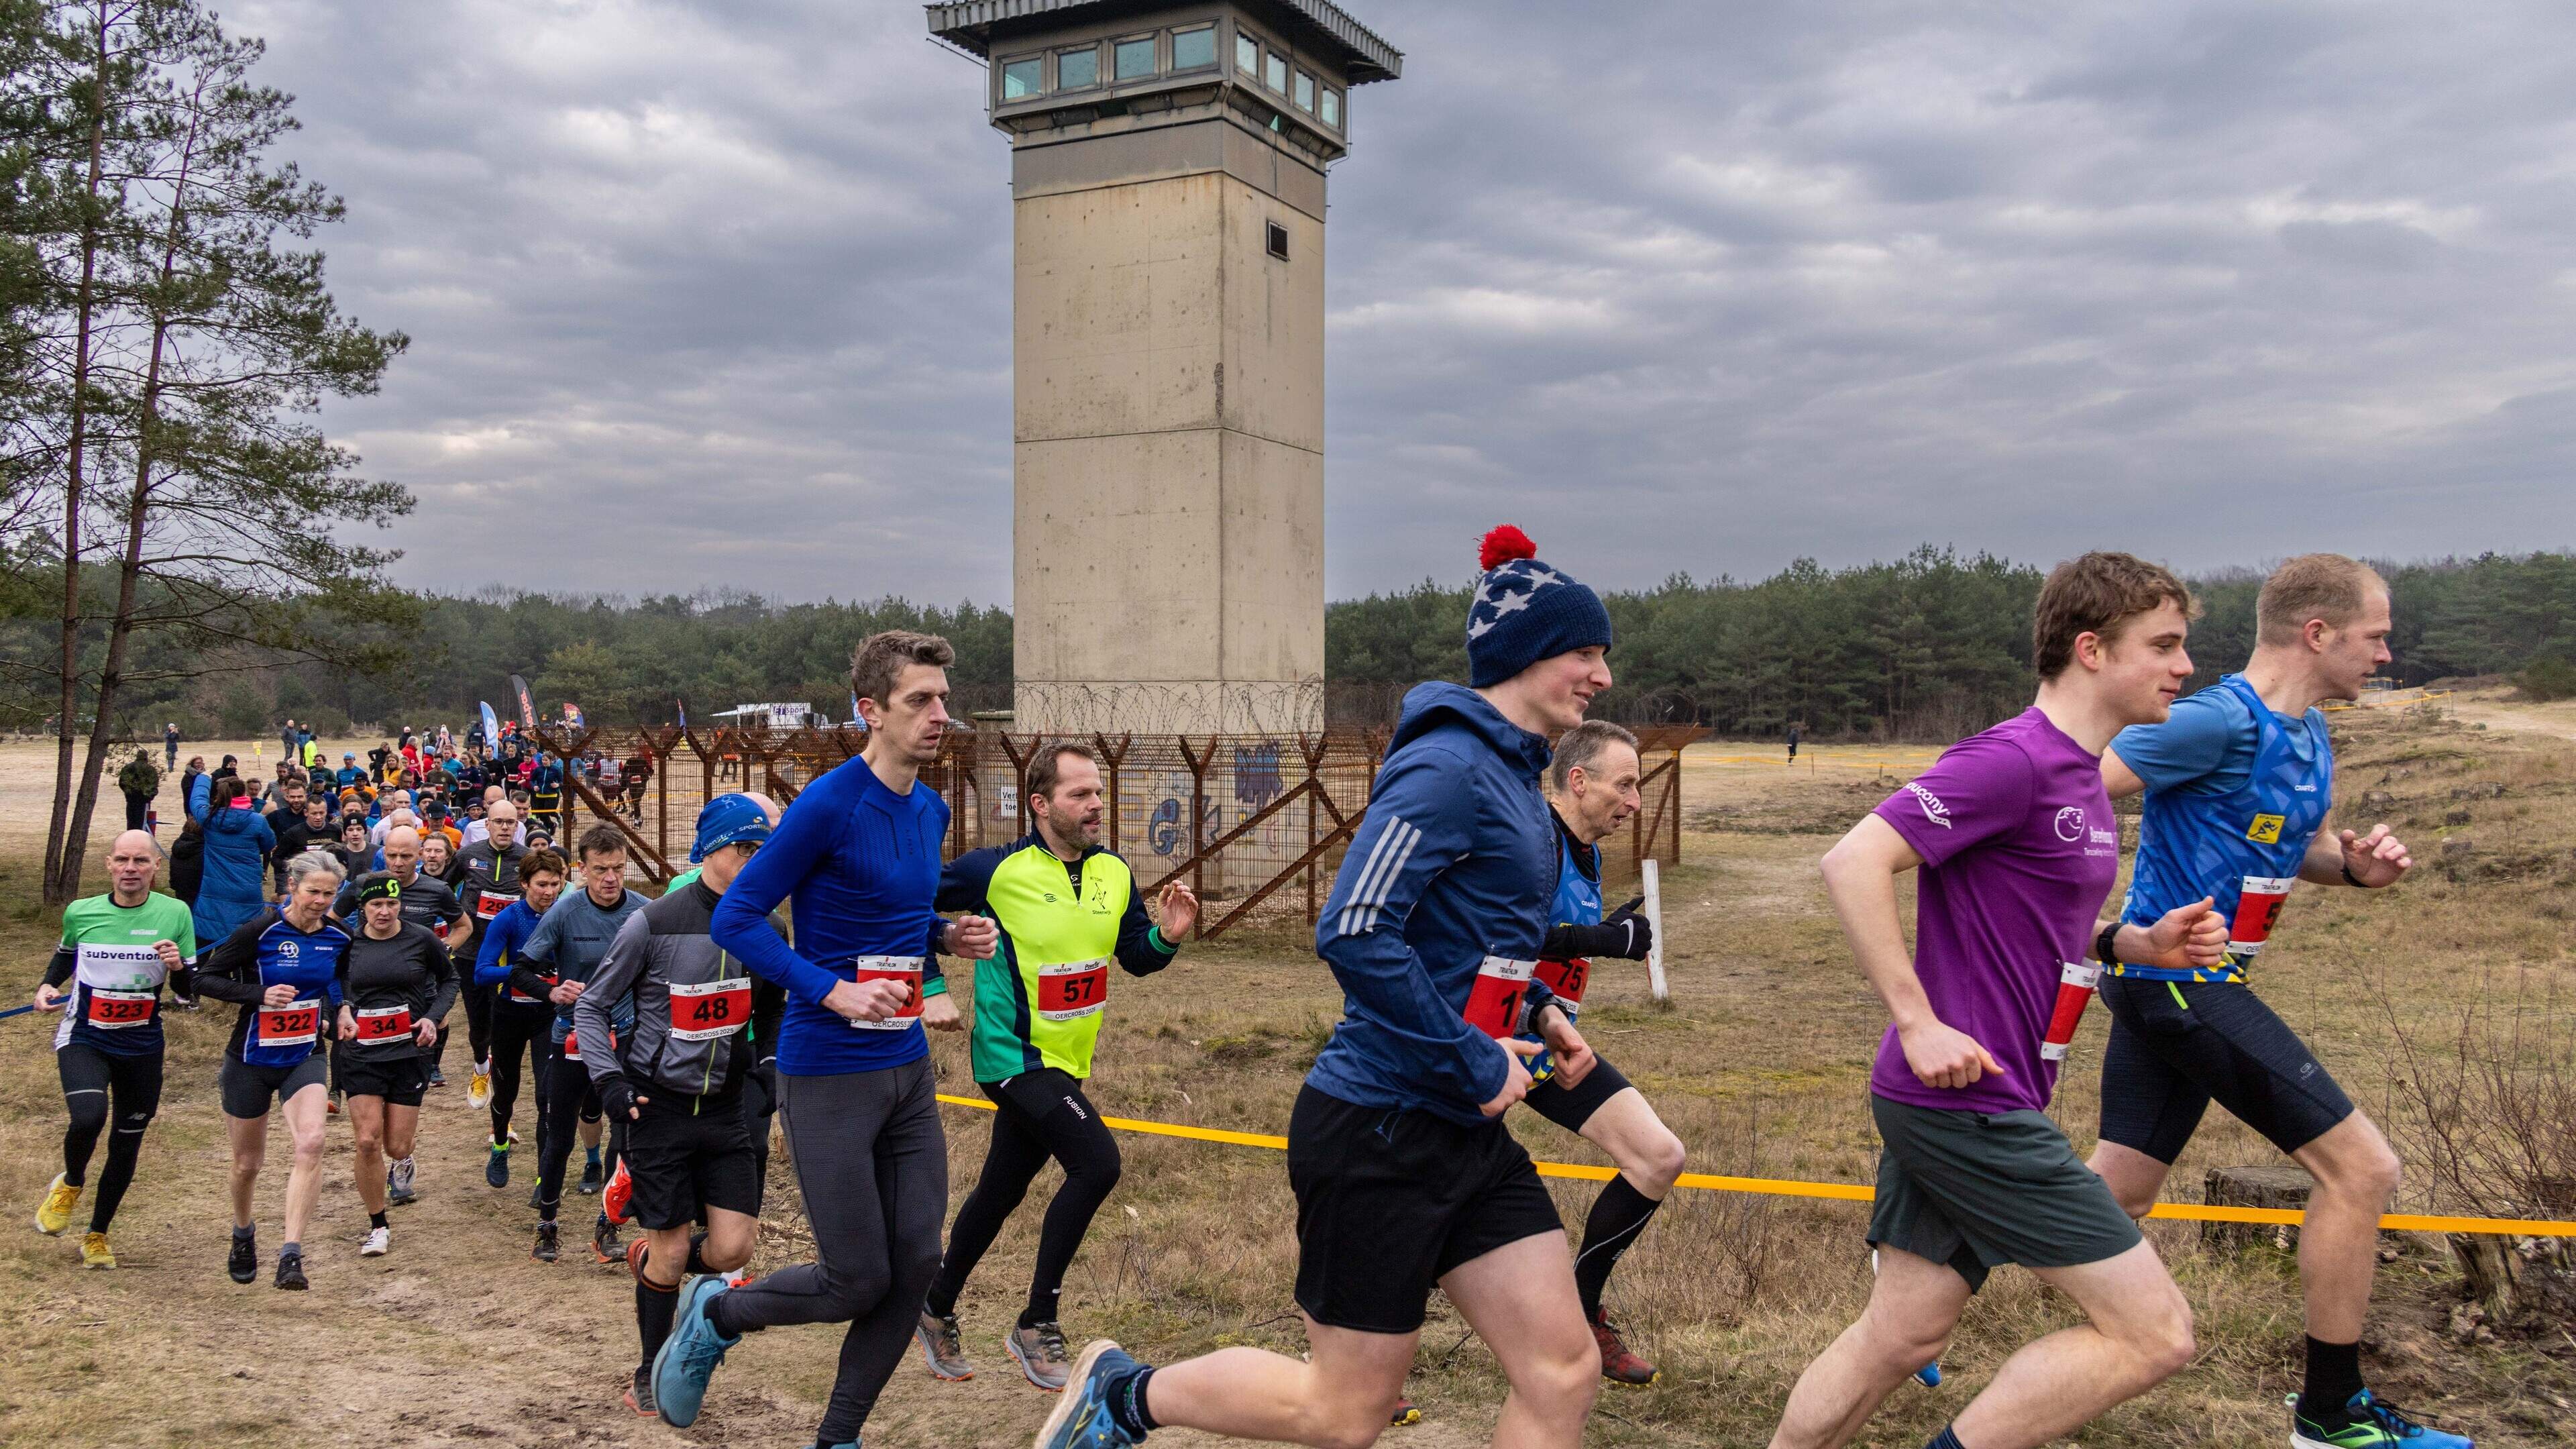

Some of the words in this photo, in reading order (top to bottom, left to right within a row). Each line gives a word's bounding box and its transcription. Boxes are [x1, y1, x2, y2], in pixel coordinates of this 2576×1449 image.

[1904, 782, 1948, 814] aucony
[1558, 962, 1584, 991] 75
[1063, 977, 1095, 1003] 57
[99, 1002, 144, 1018] 323
[693, 998, 729, 1022] 48
[1055, 1010, 1085, 1019] OERCROSS
[272, 1013, 311, 1032] 322
[371, 1018, 397, 1034] 34
[686, 1030, 718, 1039] OERCROSS
[1063, 1095, 1087, 1120] FUSION
